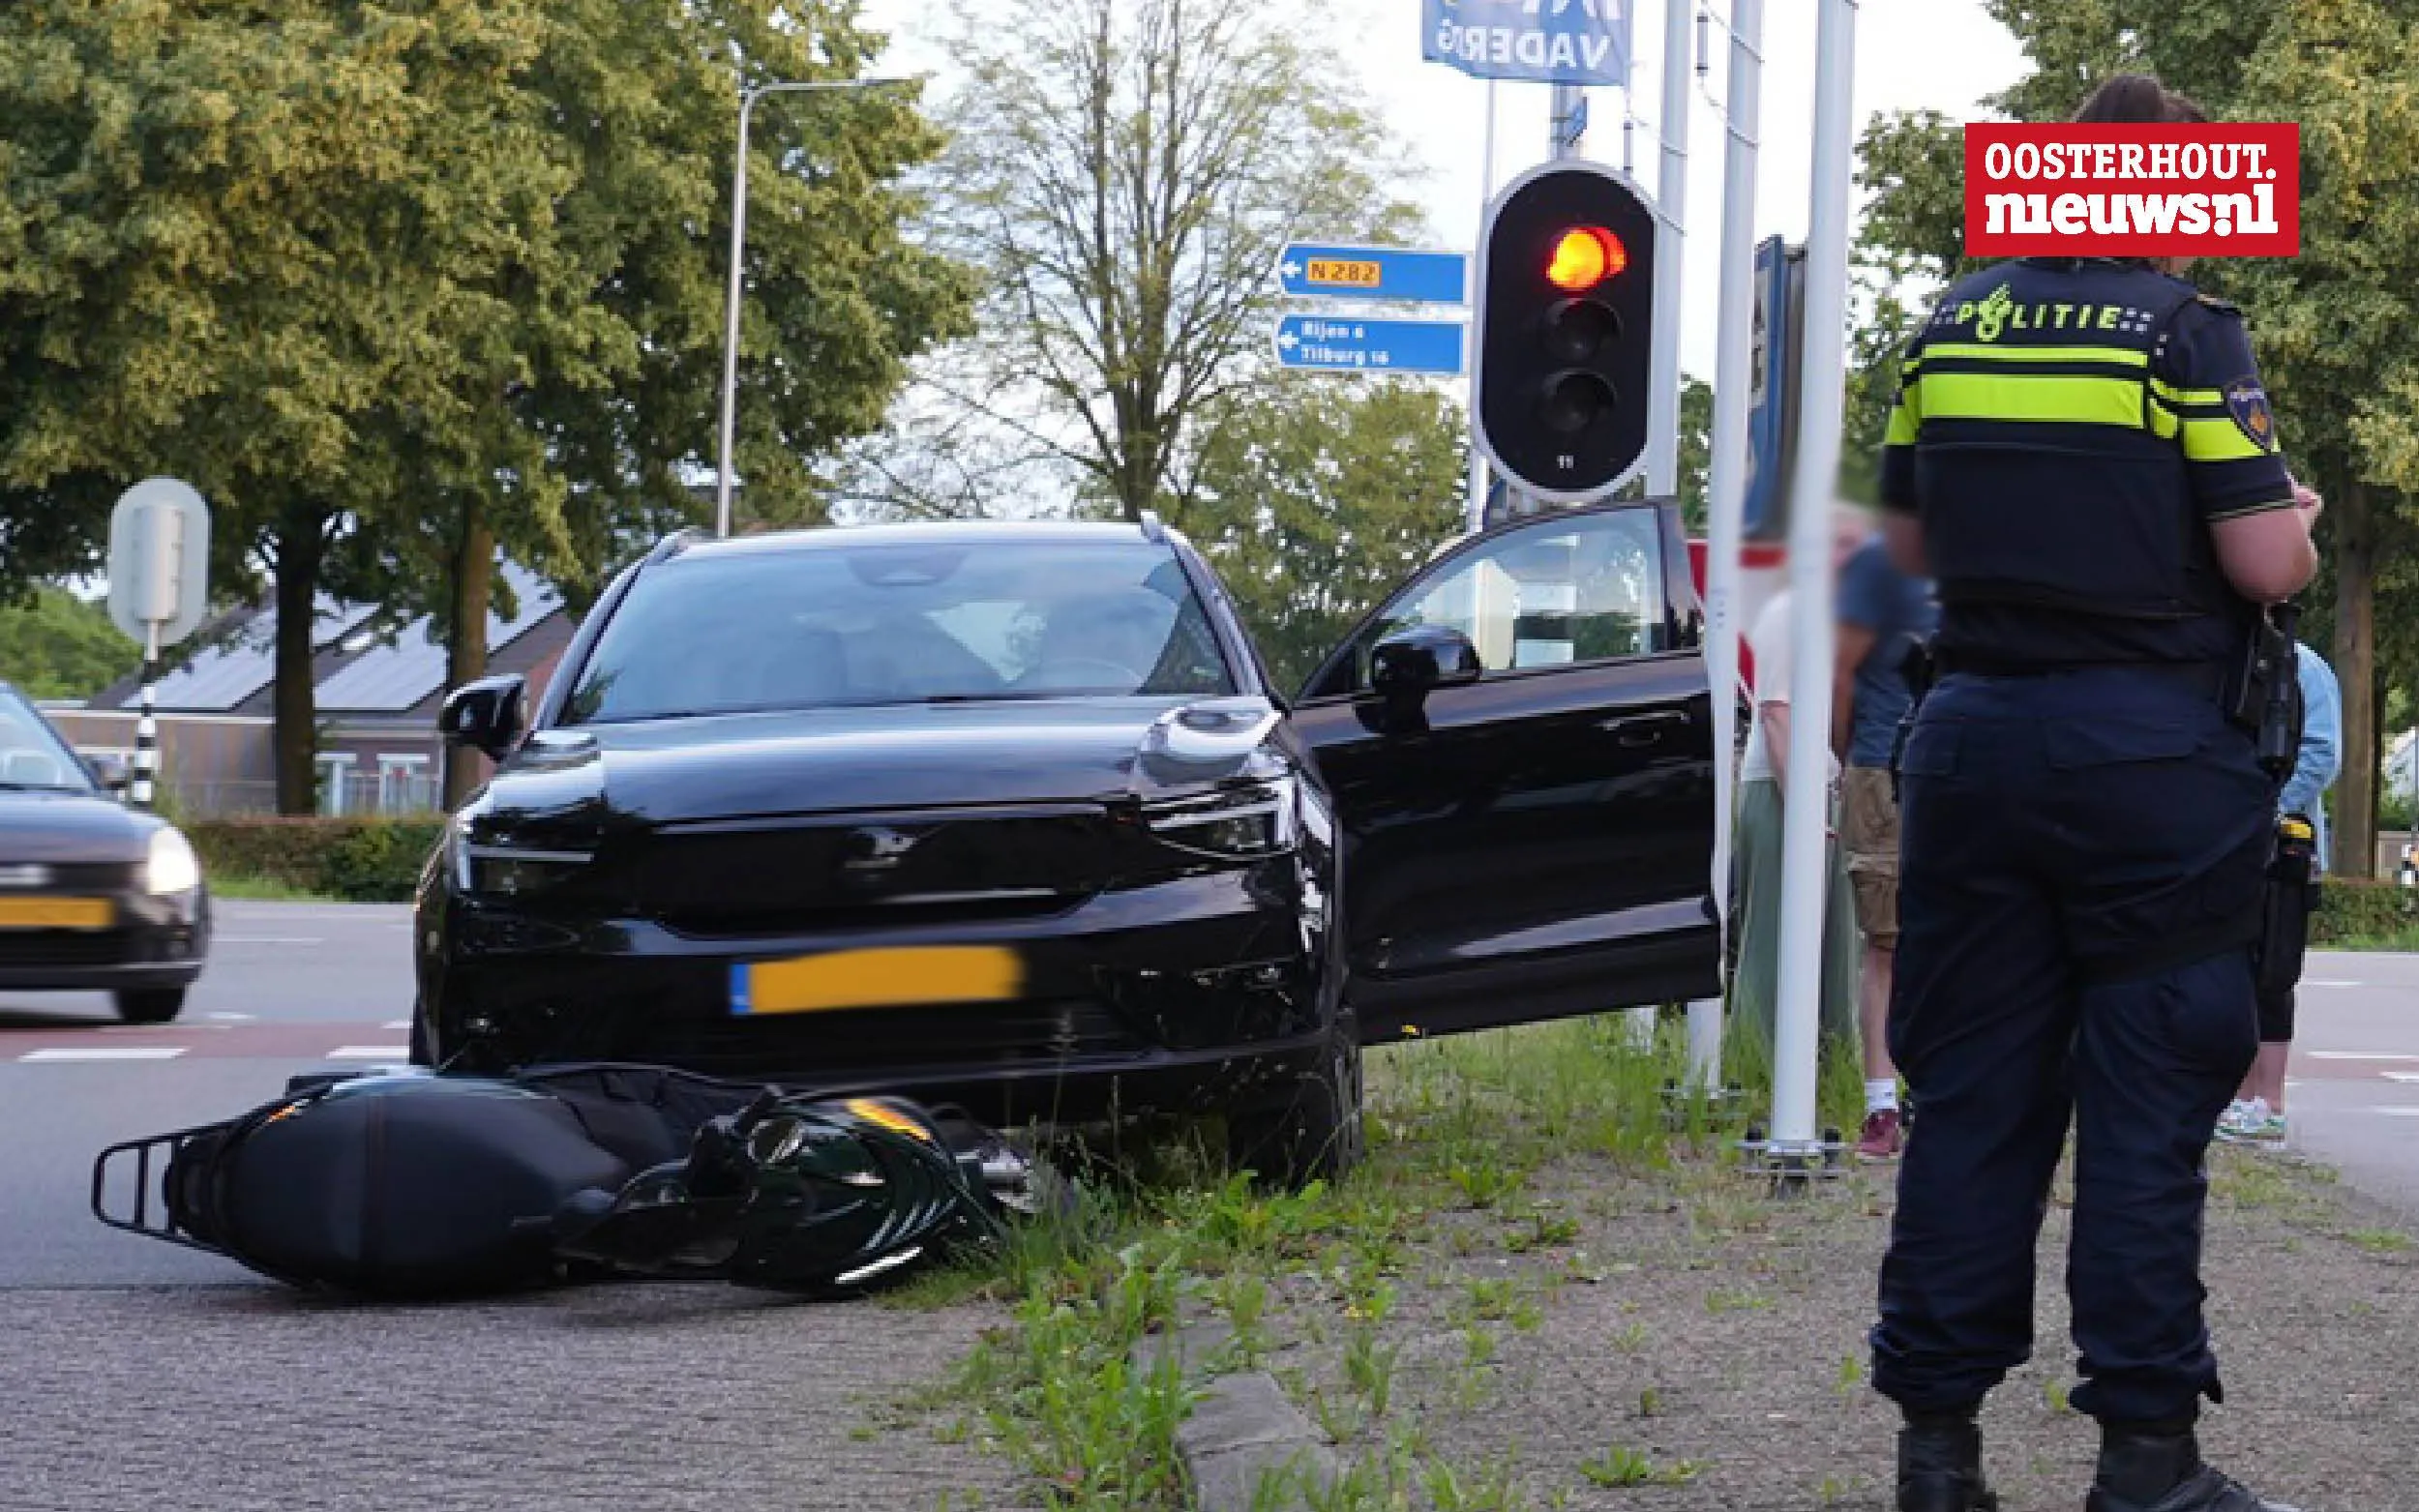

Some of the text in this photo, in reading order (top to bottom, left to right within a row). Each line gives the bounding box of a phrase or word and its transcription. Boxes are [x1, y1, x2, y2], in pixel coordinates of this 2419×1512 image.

[1311, 262, 1326, 280] N
[1955, 282, 2122, 341] POLITIE
[1301, 344, 1366, 366] Tilburg
